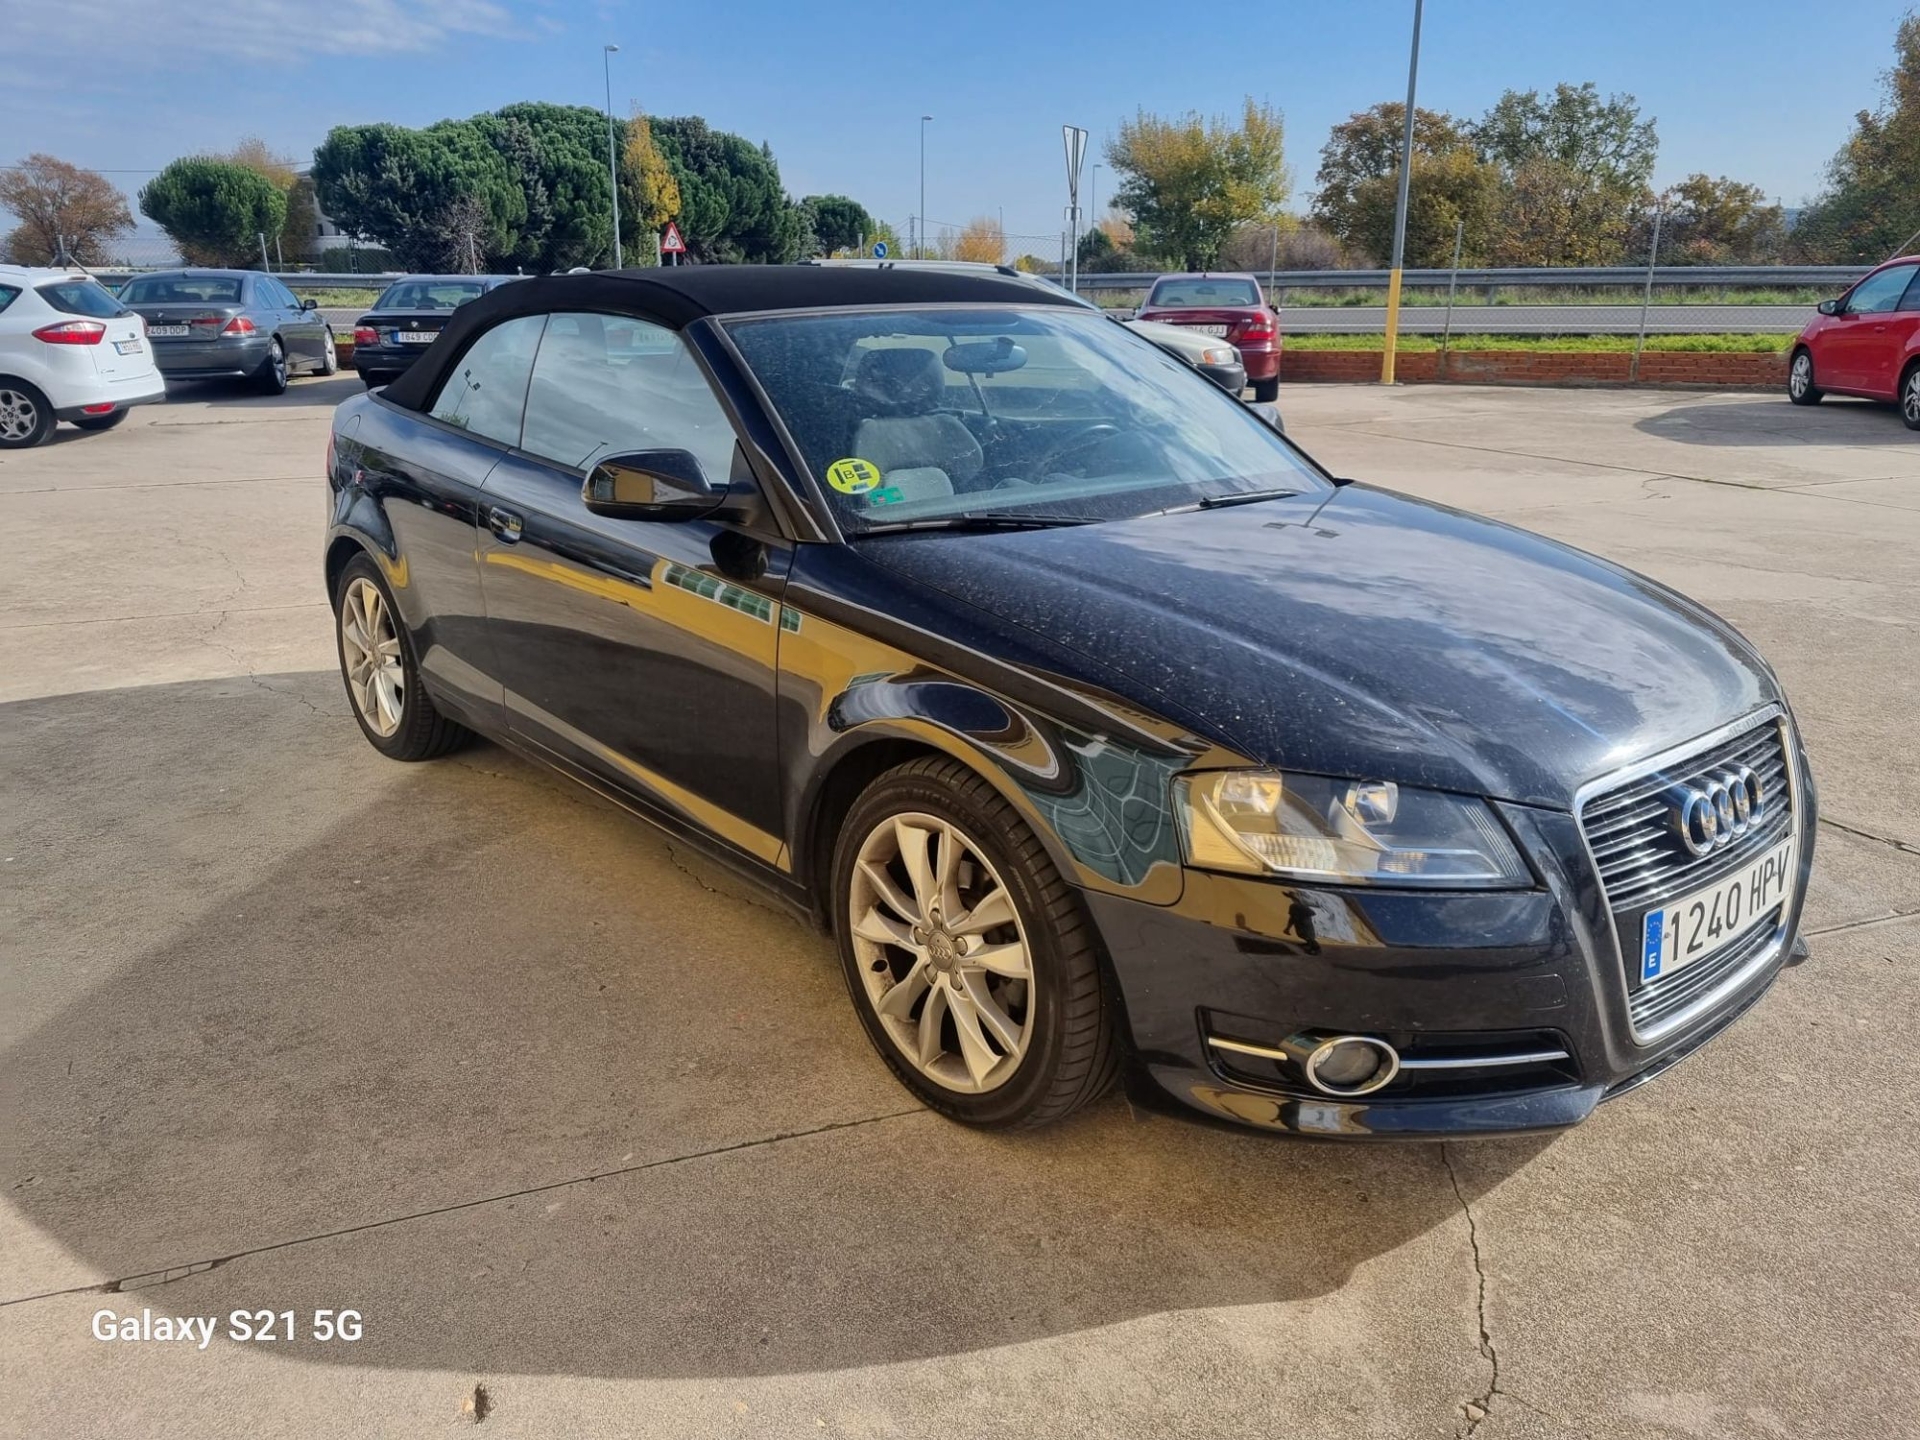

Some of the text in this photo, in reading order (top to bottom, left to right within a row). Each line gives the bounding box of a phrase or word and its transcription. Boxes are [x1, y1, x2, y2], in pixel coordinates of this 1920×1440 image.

[843, 470, 855, 479] B
[1671, 845, 1790, 961] 1240 HPV
[1648, 952, 1657, 969] E
